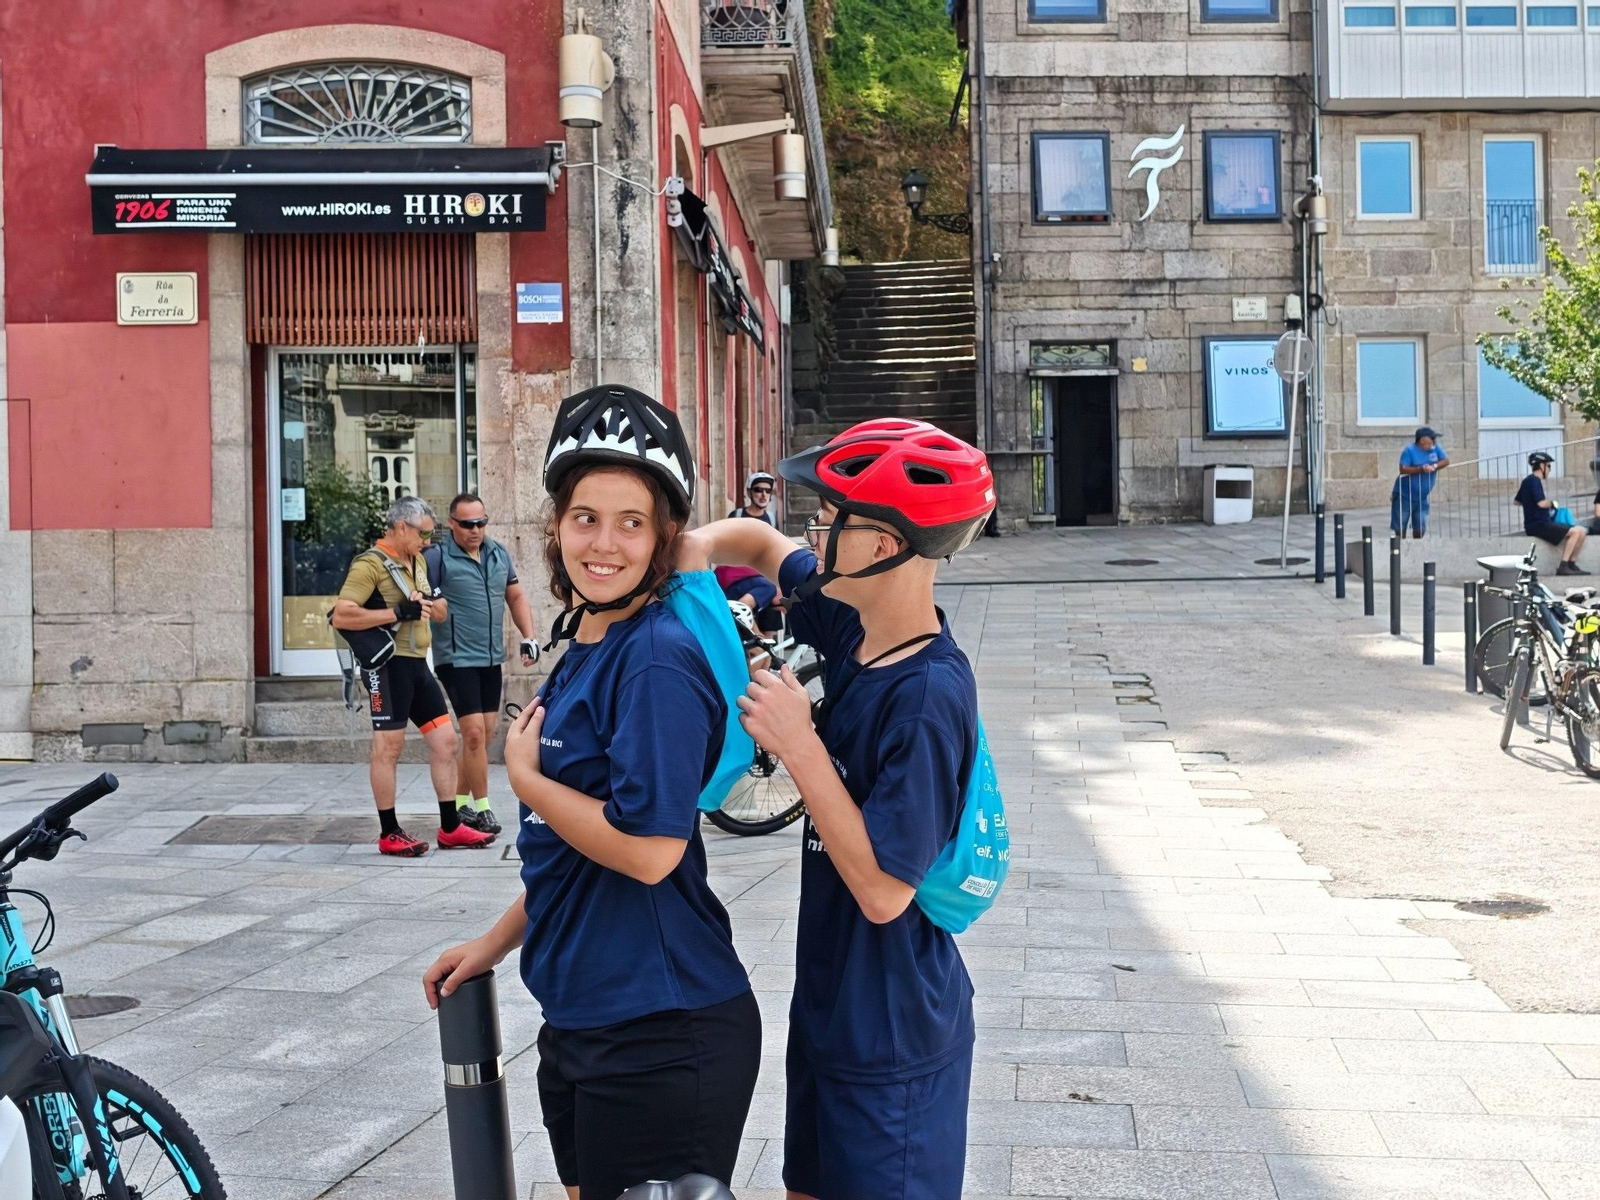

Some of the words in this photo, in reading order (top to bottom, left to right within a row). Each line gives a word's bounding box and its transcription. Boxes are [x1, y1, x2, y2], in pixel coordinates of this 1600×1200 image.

[176, 199, 206, 207] PARA
[208, 199, 232, 207] UNA
[115, 200, 171, 222] 1906
[281, 203, 391, 216] www.HIROKI.es
[406, 216, 465, 225] SUSHI
[489, 215, 522, 224] BAR
[157, 294, 169, 304] da
[518, 295, 542, 304] BOSCH
[130, 305, 184, 317] Ferrería
[1224, 367, 1268, 376] VINOS
[368, 670, 382, 713] obbybike
[42, 1092, 67, 1150] ORB
